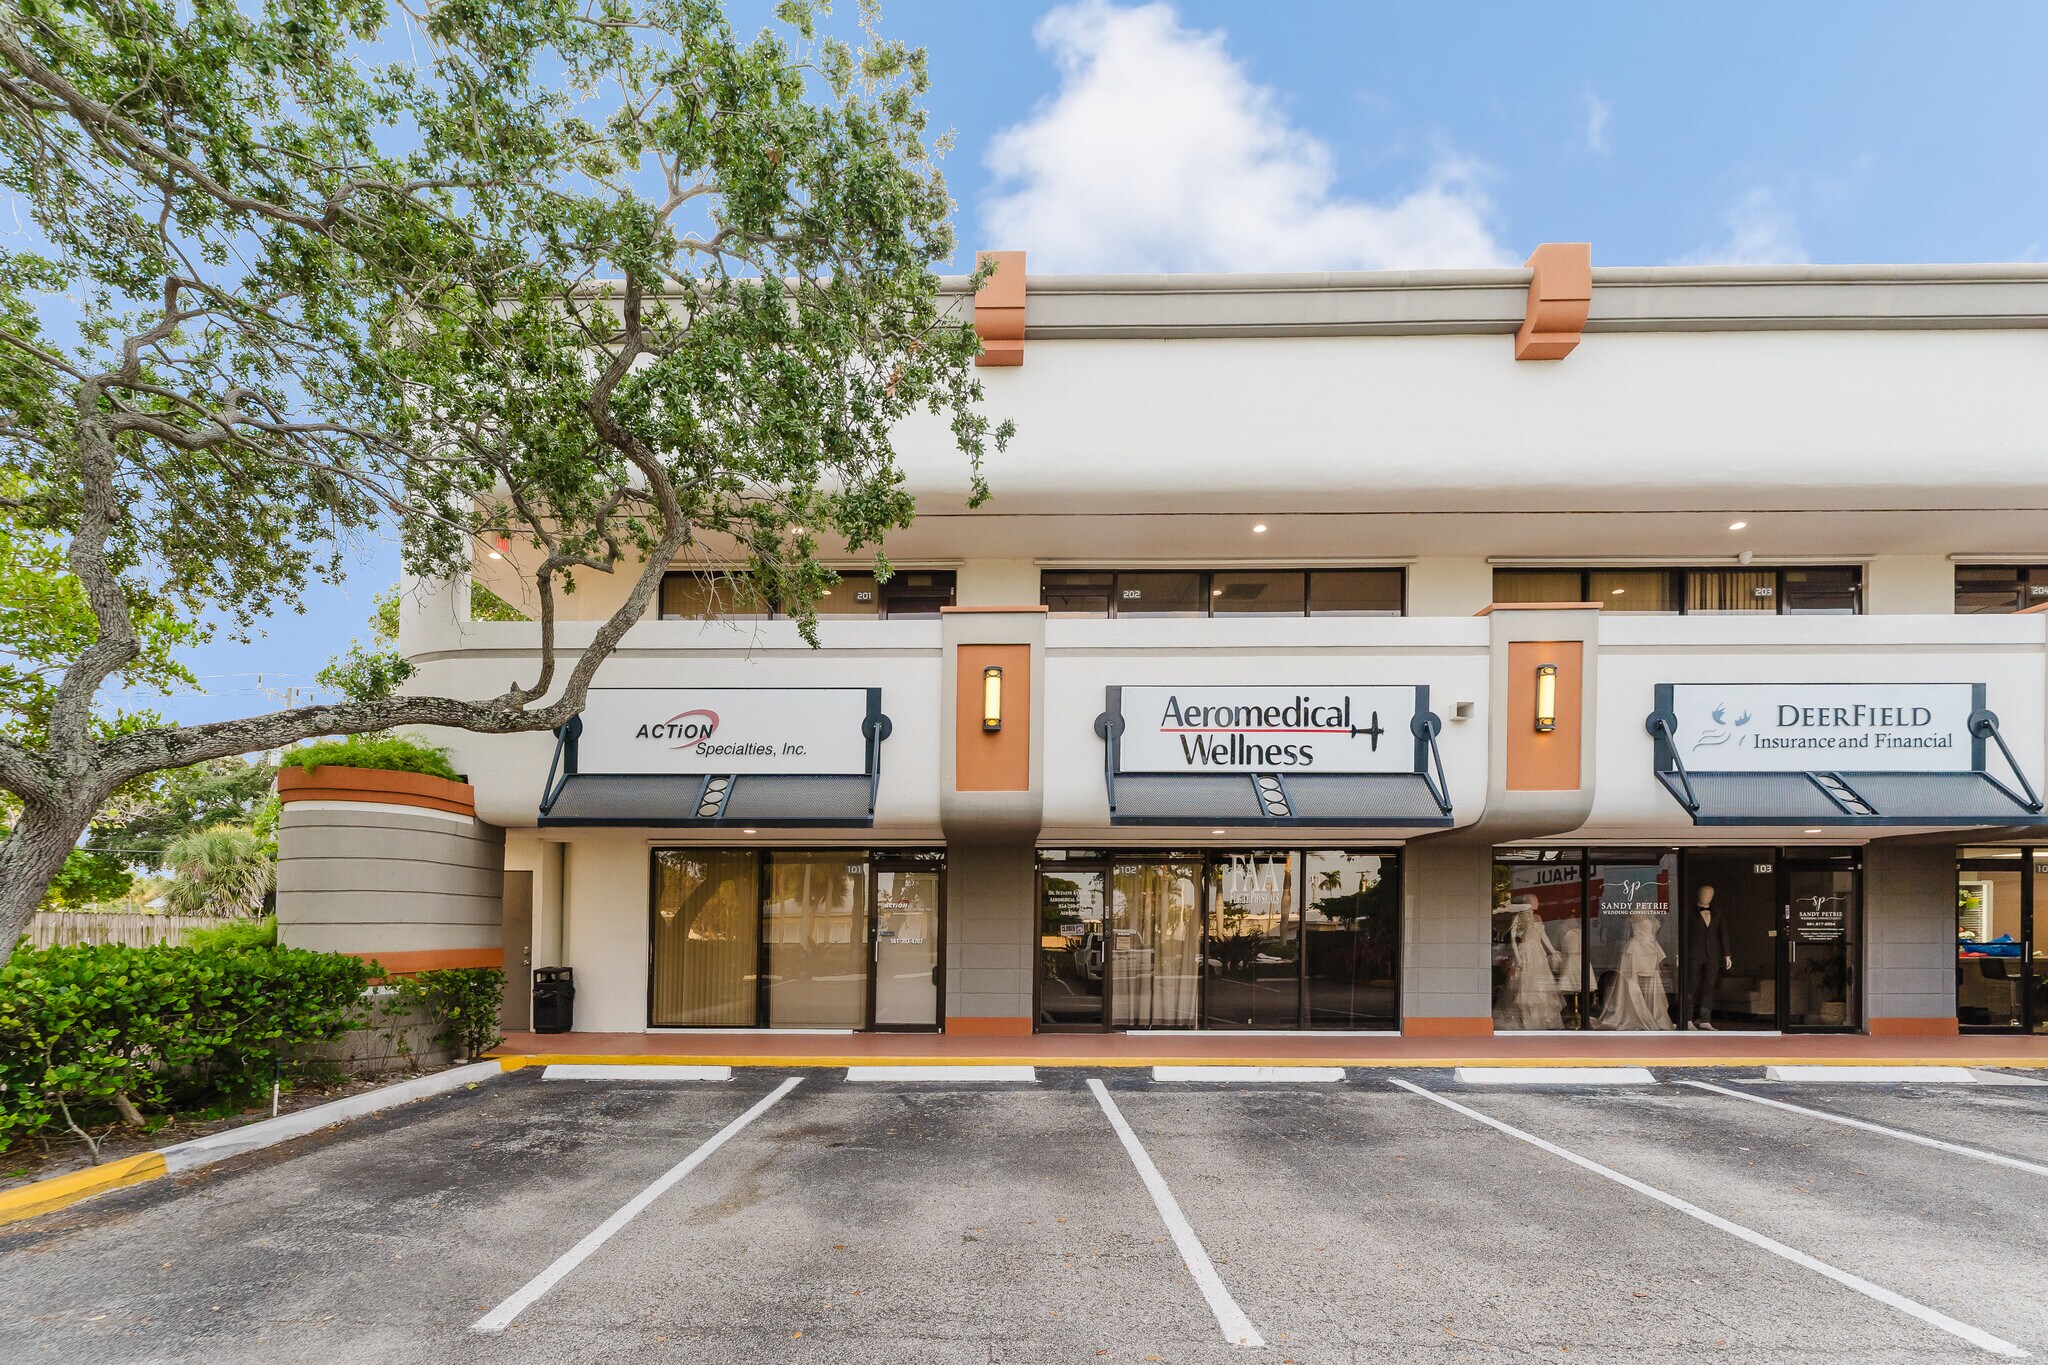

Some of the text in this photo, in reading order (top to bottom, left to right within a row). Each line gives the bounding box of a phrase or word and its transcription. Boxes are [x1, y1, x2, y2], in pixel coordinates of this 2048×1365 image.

[857, 592, 871, 600] 201
[1123, 590, 1140, 598] 202
[1755, 587, 1772, 596] 203
[1161, 695, 1350, 727] Aeromedical
[1776, 704, 1932, 727] DEERFIELD
[1753, 733, 1953, 749] Insurance and Financial
[695, 742, 807, 757] Specialties, Inc.
[1180, 734, 1313, 765] Wellness
[847, 865, 861, 873] 101
[1120, 866, 1137, 874] 102
[1229, 854, 1279, 892] FAA
[1755, 864, 1772, 873] 103
[2036, 865, 2048, 873] 10
[1601, 902, 1669, 910] SANDY PETRIE
